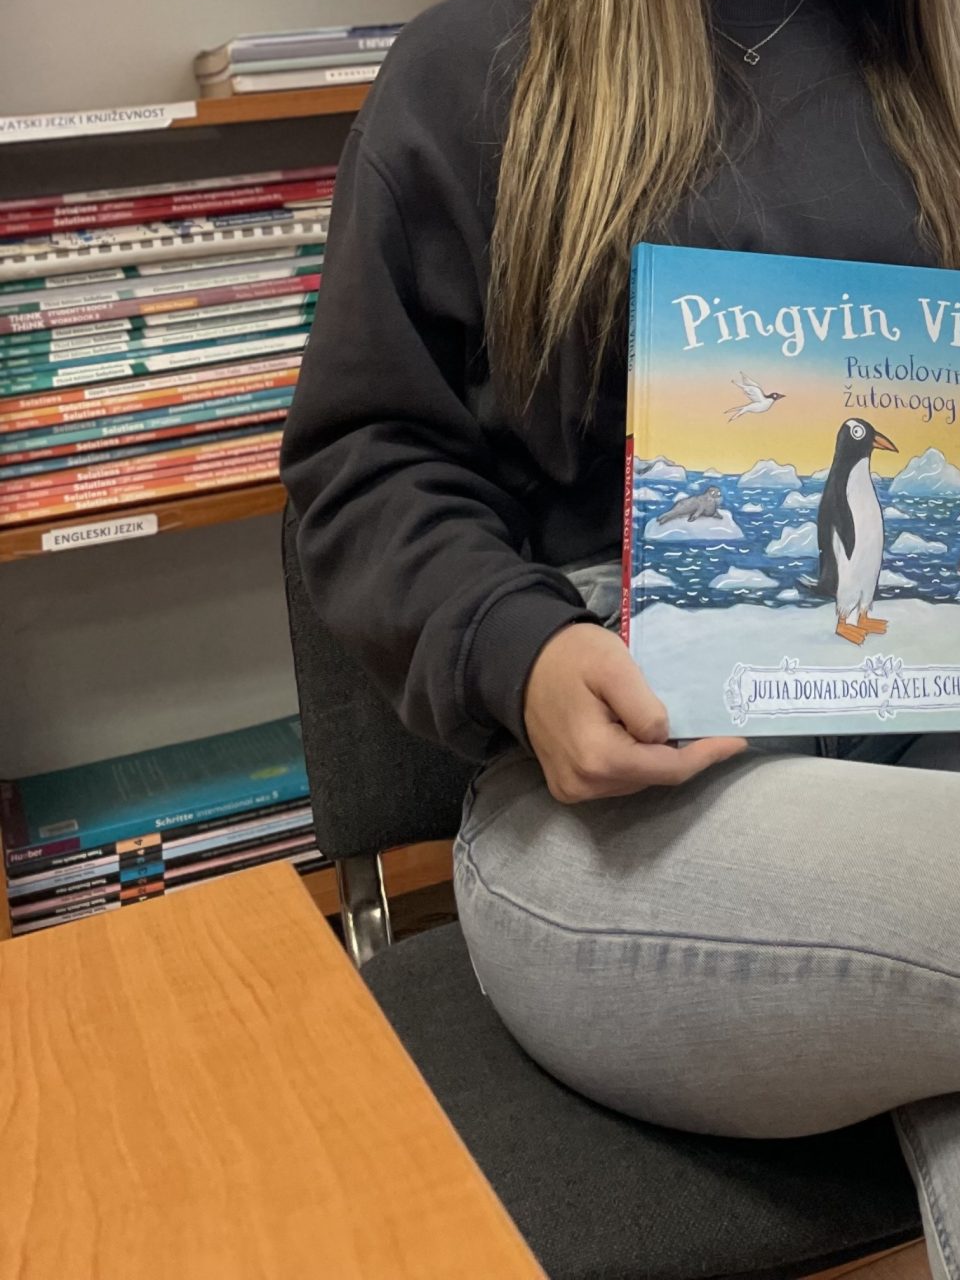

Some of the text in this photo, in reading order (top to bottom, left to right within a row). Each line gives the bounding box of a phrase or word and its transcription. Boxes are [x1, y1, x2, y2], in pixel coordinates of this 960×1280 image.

[45, 115, 76, 128] JEZIK
[79, 114, 83, 125] I
[86, 108, 165, 125] KNJIŽEVNOST
[671, 293, 901, 357] Pingvin
[842, 384, 956, 425] žutonogog
[102, 422, 144, 436] Solutions
[77, 469, 120, 481] Solutions
[73, 480, 117, 492] Solutions
[64, 490, 108, 502] Solutions
[54, 521, 144, 545] ENGLESKI JEZIK
[748, 678, 790, 703] JULIA
[792, 677, 879, 701] DONALDSON
[889, 675, 930, 699] AXEL
[154, 812, 194, 829] Schritte
